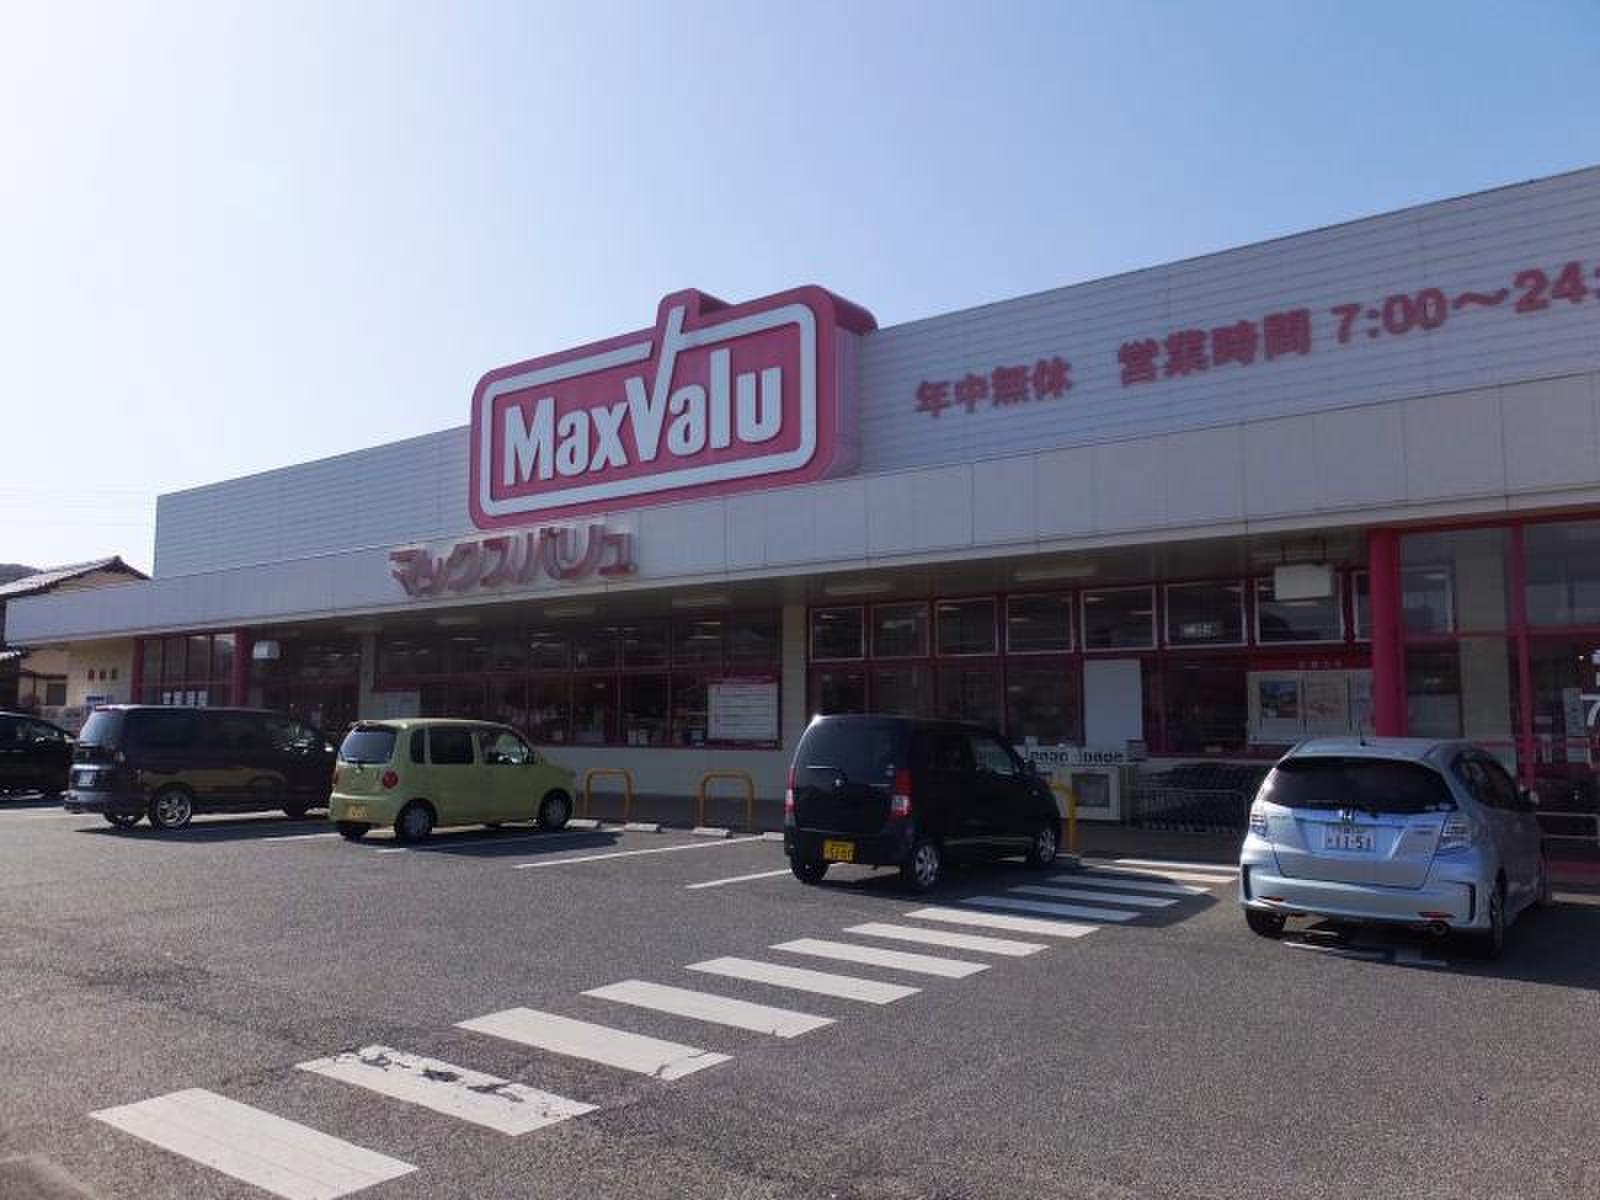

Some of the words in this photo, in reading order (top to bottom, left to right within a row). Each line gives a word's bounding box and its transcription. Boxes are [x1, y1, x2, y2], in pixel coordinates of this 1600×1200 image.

[504, 305, 782, 486] MaxValu
[915, 356, 1073, 418] 年中無休
[1117, 309, 1311, 386] 営業時間
[389, 525, 637, 597] マックスバリュ
